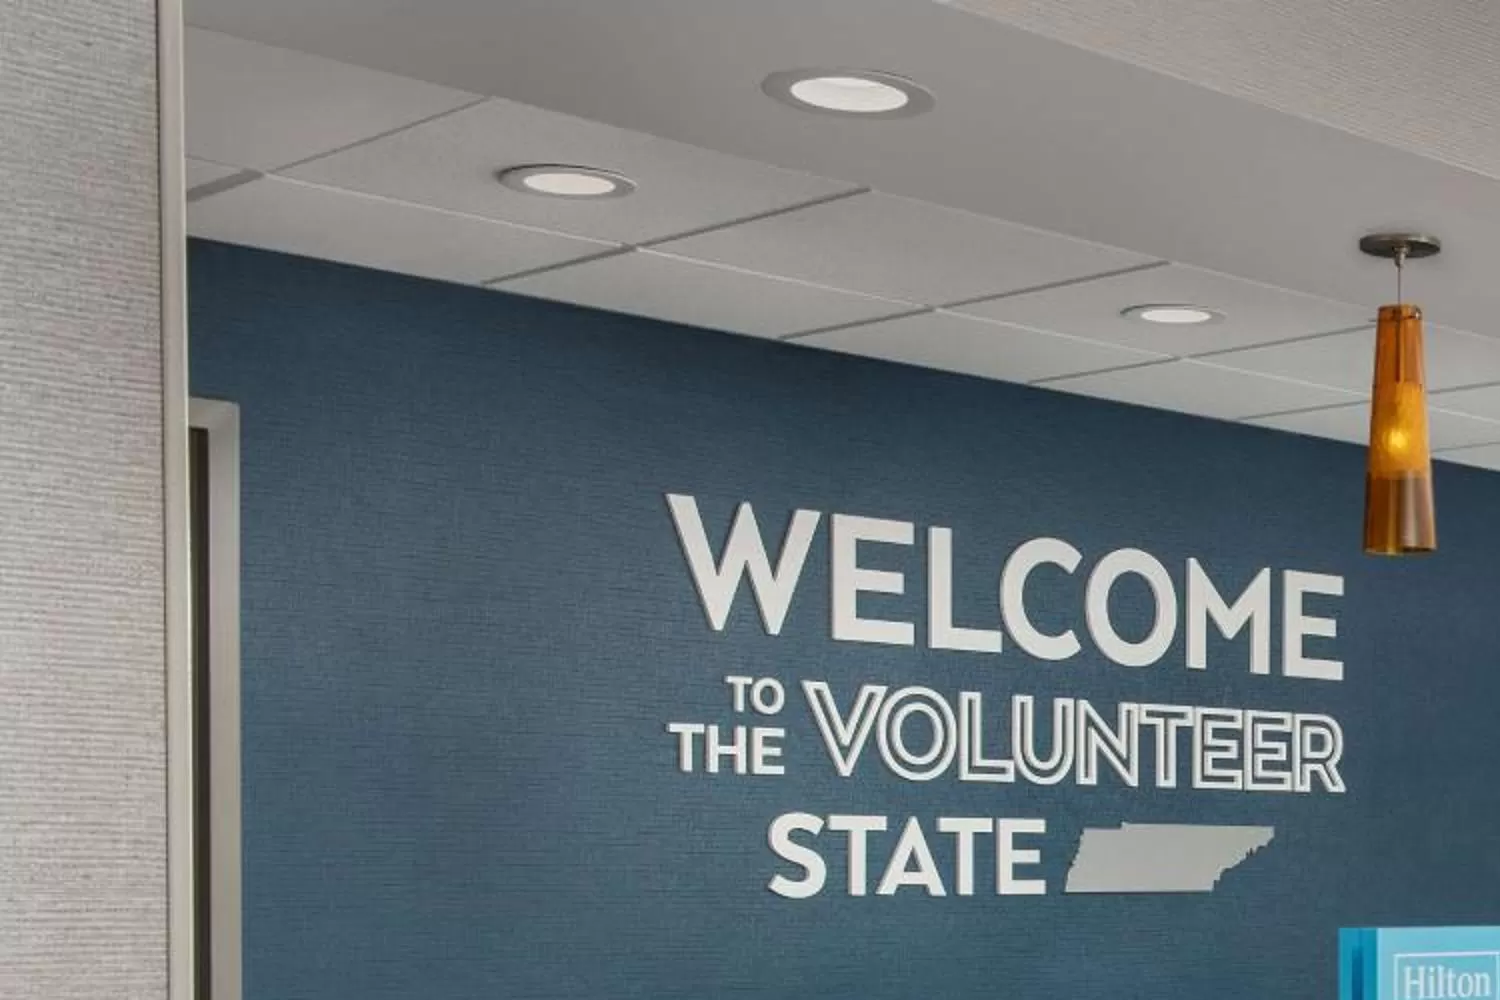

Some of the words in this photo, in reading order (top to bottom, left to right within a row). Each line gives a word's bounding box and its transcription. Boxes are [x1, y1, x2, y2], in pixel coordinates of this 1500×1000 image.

[665, 493, 1346, 682] WELCOME
[668, 722, 786, 775] THE
[801, 679, 1347, 793] VOLUNTEER
[725, 675, 785, 715] TO
[767, 811, 1047, 899] STATE
[1404, 964, 1492, 1000] Hilton
